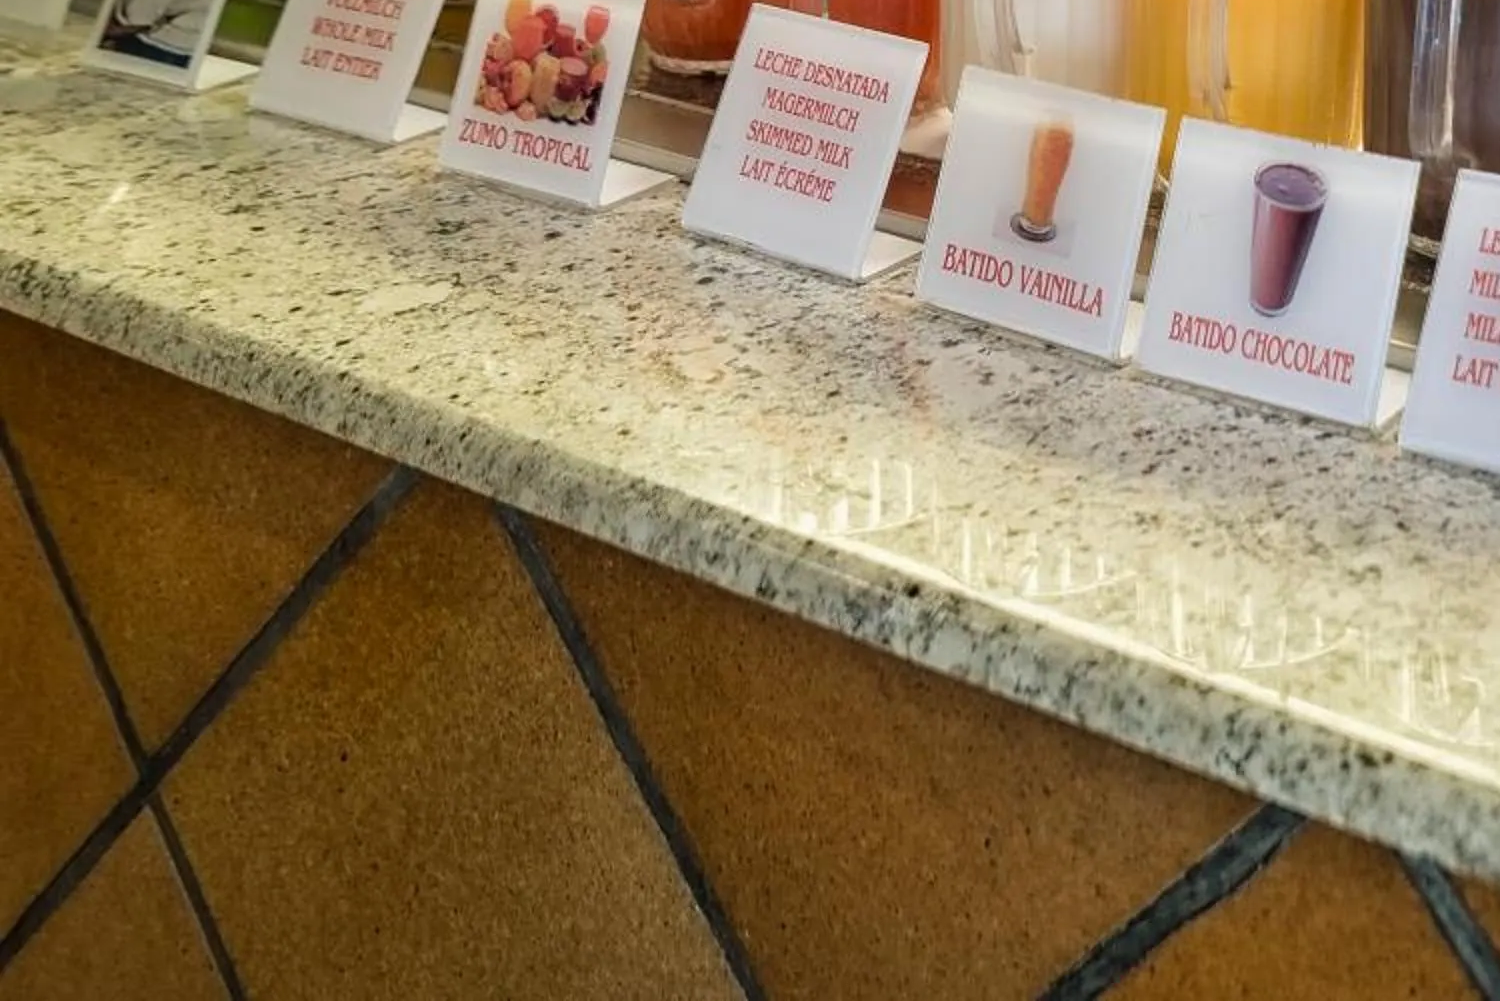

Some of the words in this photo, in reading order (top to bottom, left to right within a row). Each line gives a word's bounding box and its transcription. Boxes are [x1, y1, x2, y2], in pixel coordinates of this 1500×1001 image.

[754, 48, 803, 79] LECHE
[801, 60, 890, 104] DESNATADA
[762, 86, 860, 133] MAGERMILCH
[459, 118, 507, 149] ZUMO
[512, 130, 591, 171] TROPICAL
[739, 155, 774, 183] LAIT
[746, 119, 813, 157] SKIMMED
[815, 139, 855, 170] MILK
[943, 244, 1013, 288] BATIDO
[1020, 265, 1103, 317] VAINILLA
[1168, 311, 1237, 354] BATIDO
[1240, 328, 1355, 384] CHOCOLATE
[1452, 355, 1499, 389] LAIT
